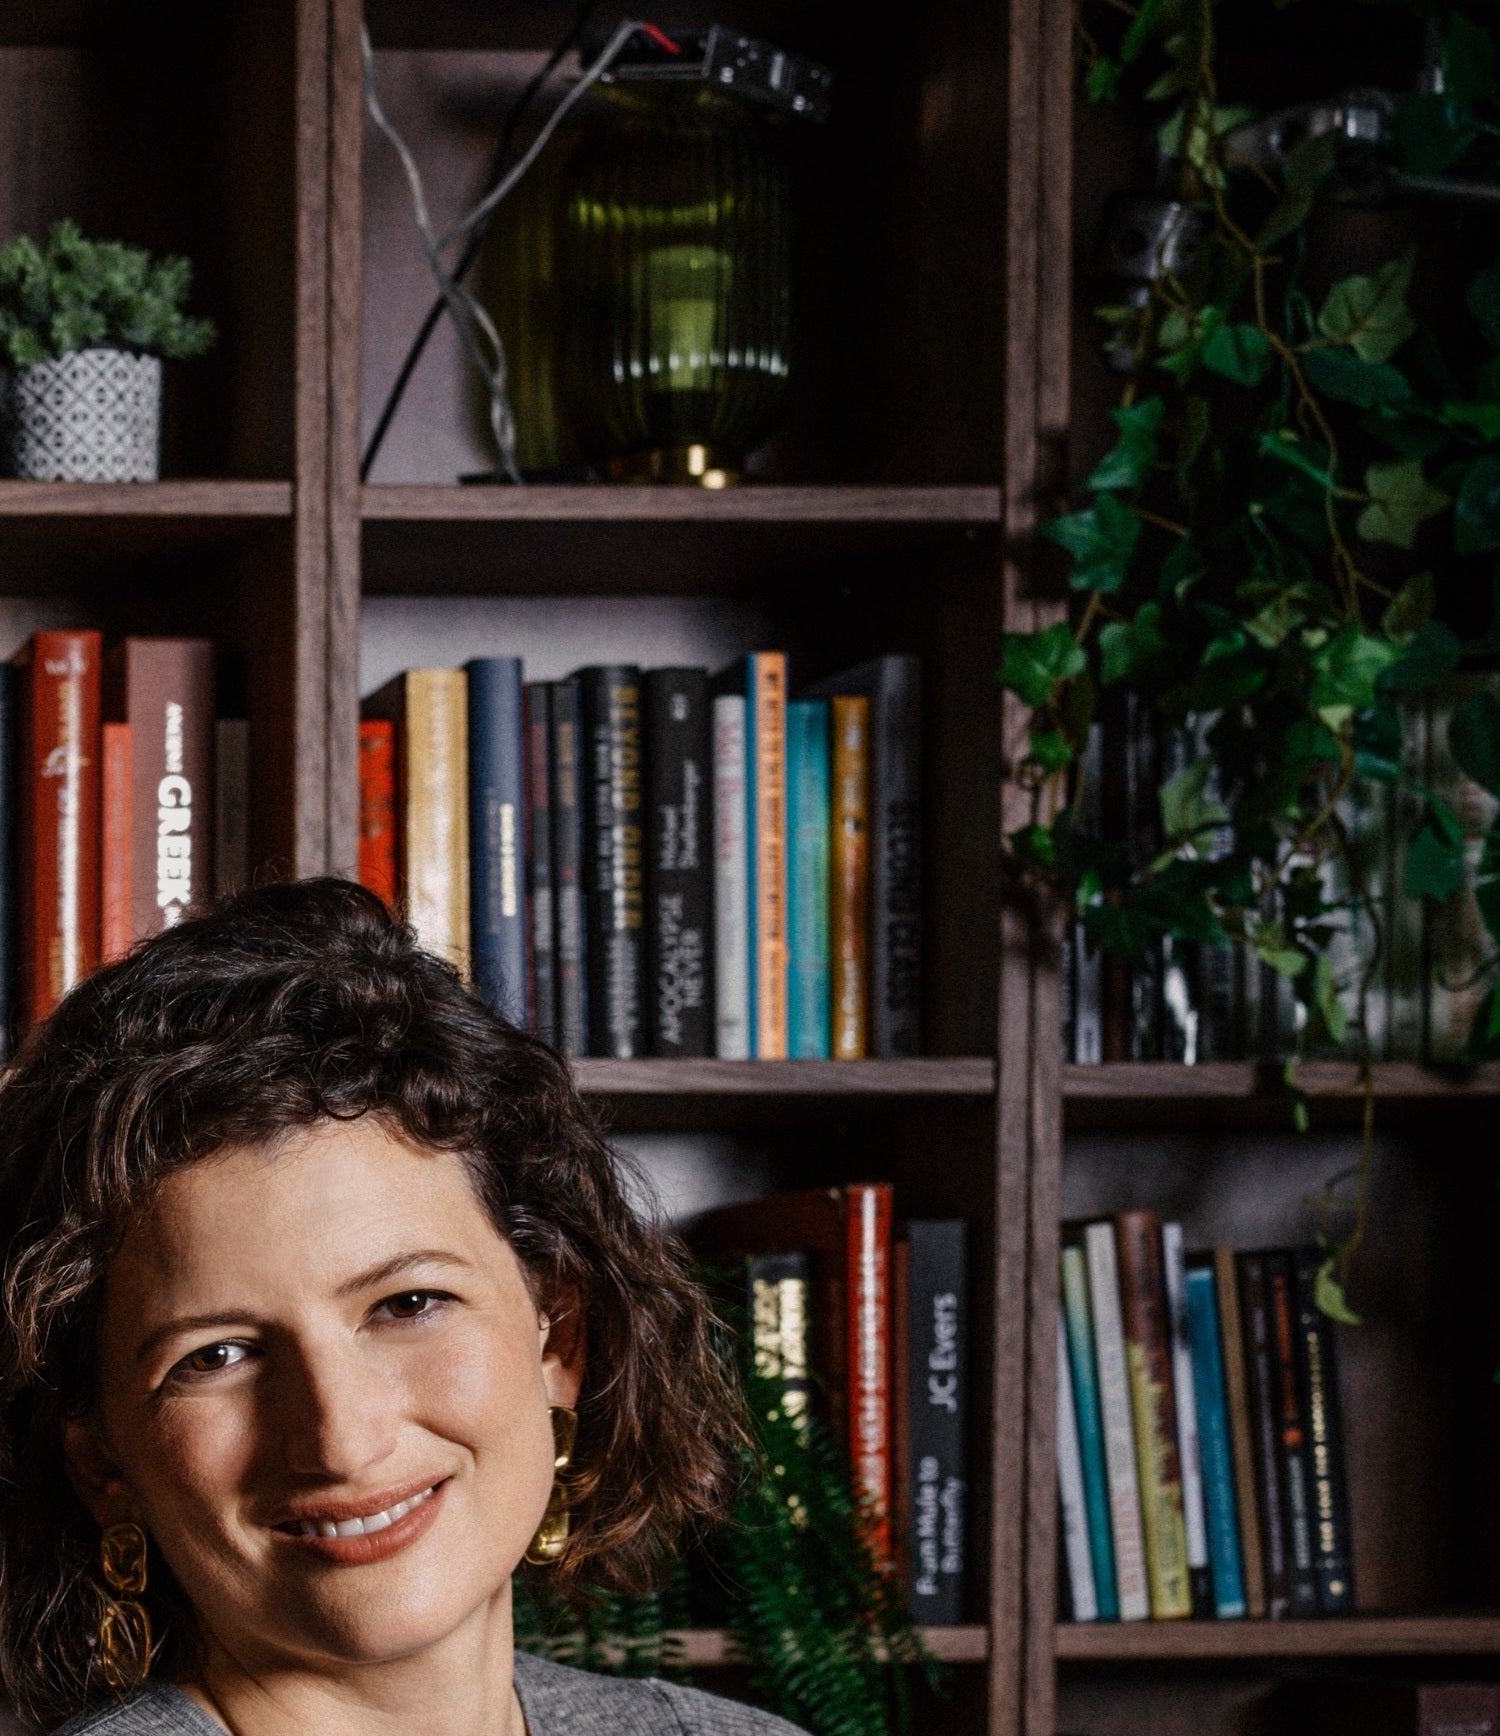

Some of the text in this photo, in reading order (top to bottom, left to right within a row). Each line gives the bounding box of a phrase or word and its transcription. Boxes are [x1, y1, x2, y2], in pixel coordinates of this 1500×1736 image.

[612, 685, 640, 812] BEYOND
[156, 774, 192, 908] GREEK
[614, 823, 642, 930] ORDER
[659, 804, 678, 871] Michael
[659, 893, 683, 1046] APOCALYPSE
[680, 926, 702, 1009] NEVER
[928, 1292, 958, 1415] JC Evers
[919, 1455, 939, 1482] to
[916, 1545, 939, 1597] From
[940, 1474, 964, 1574] Butterfly
